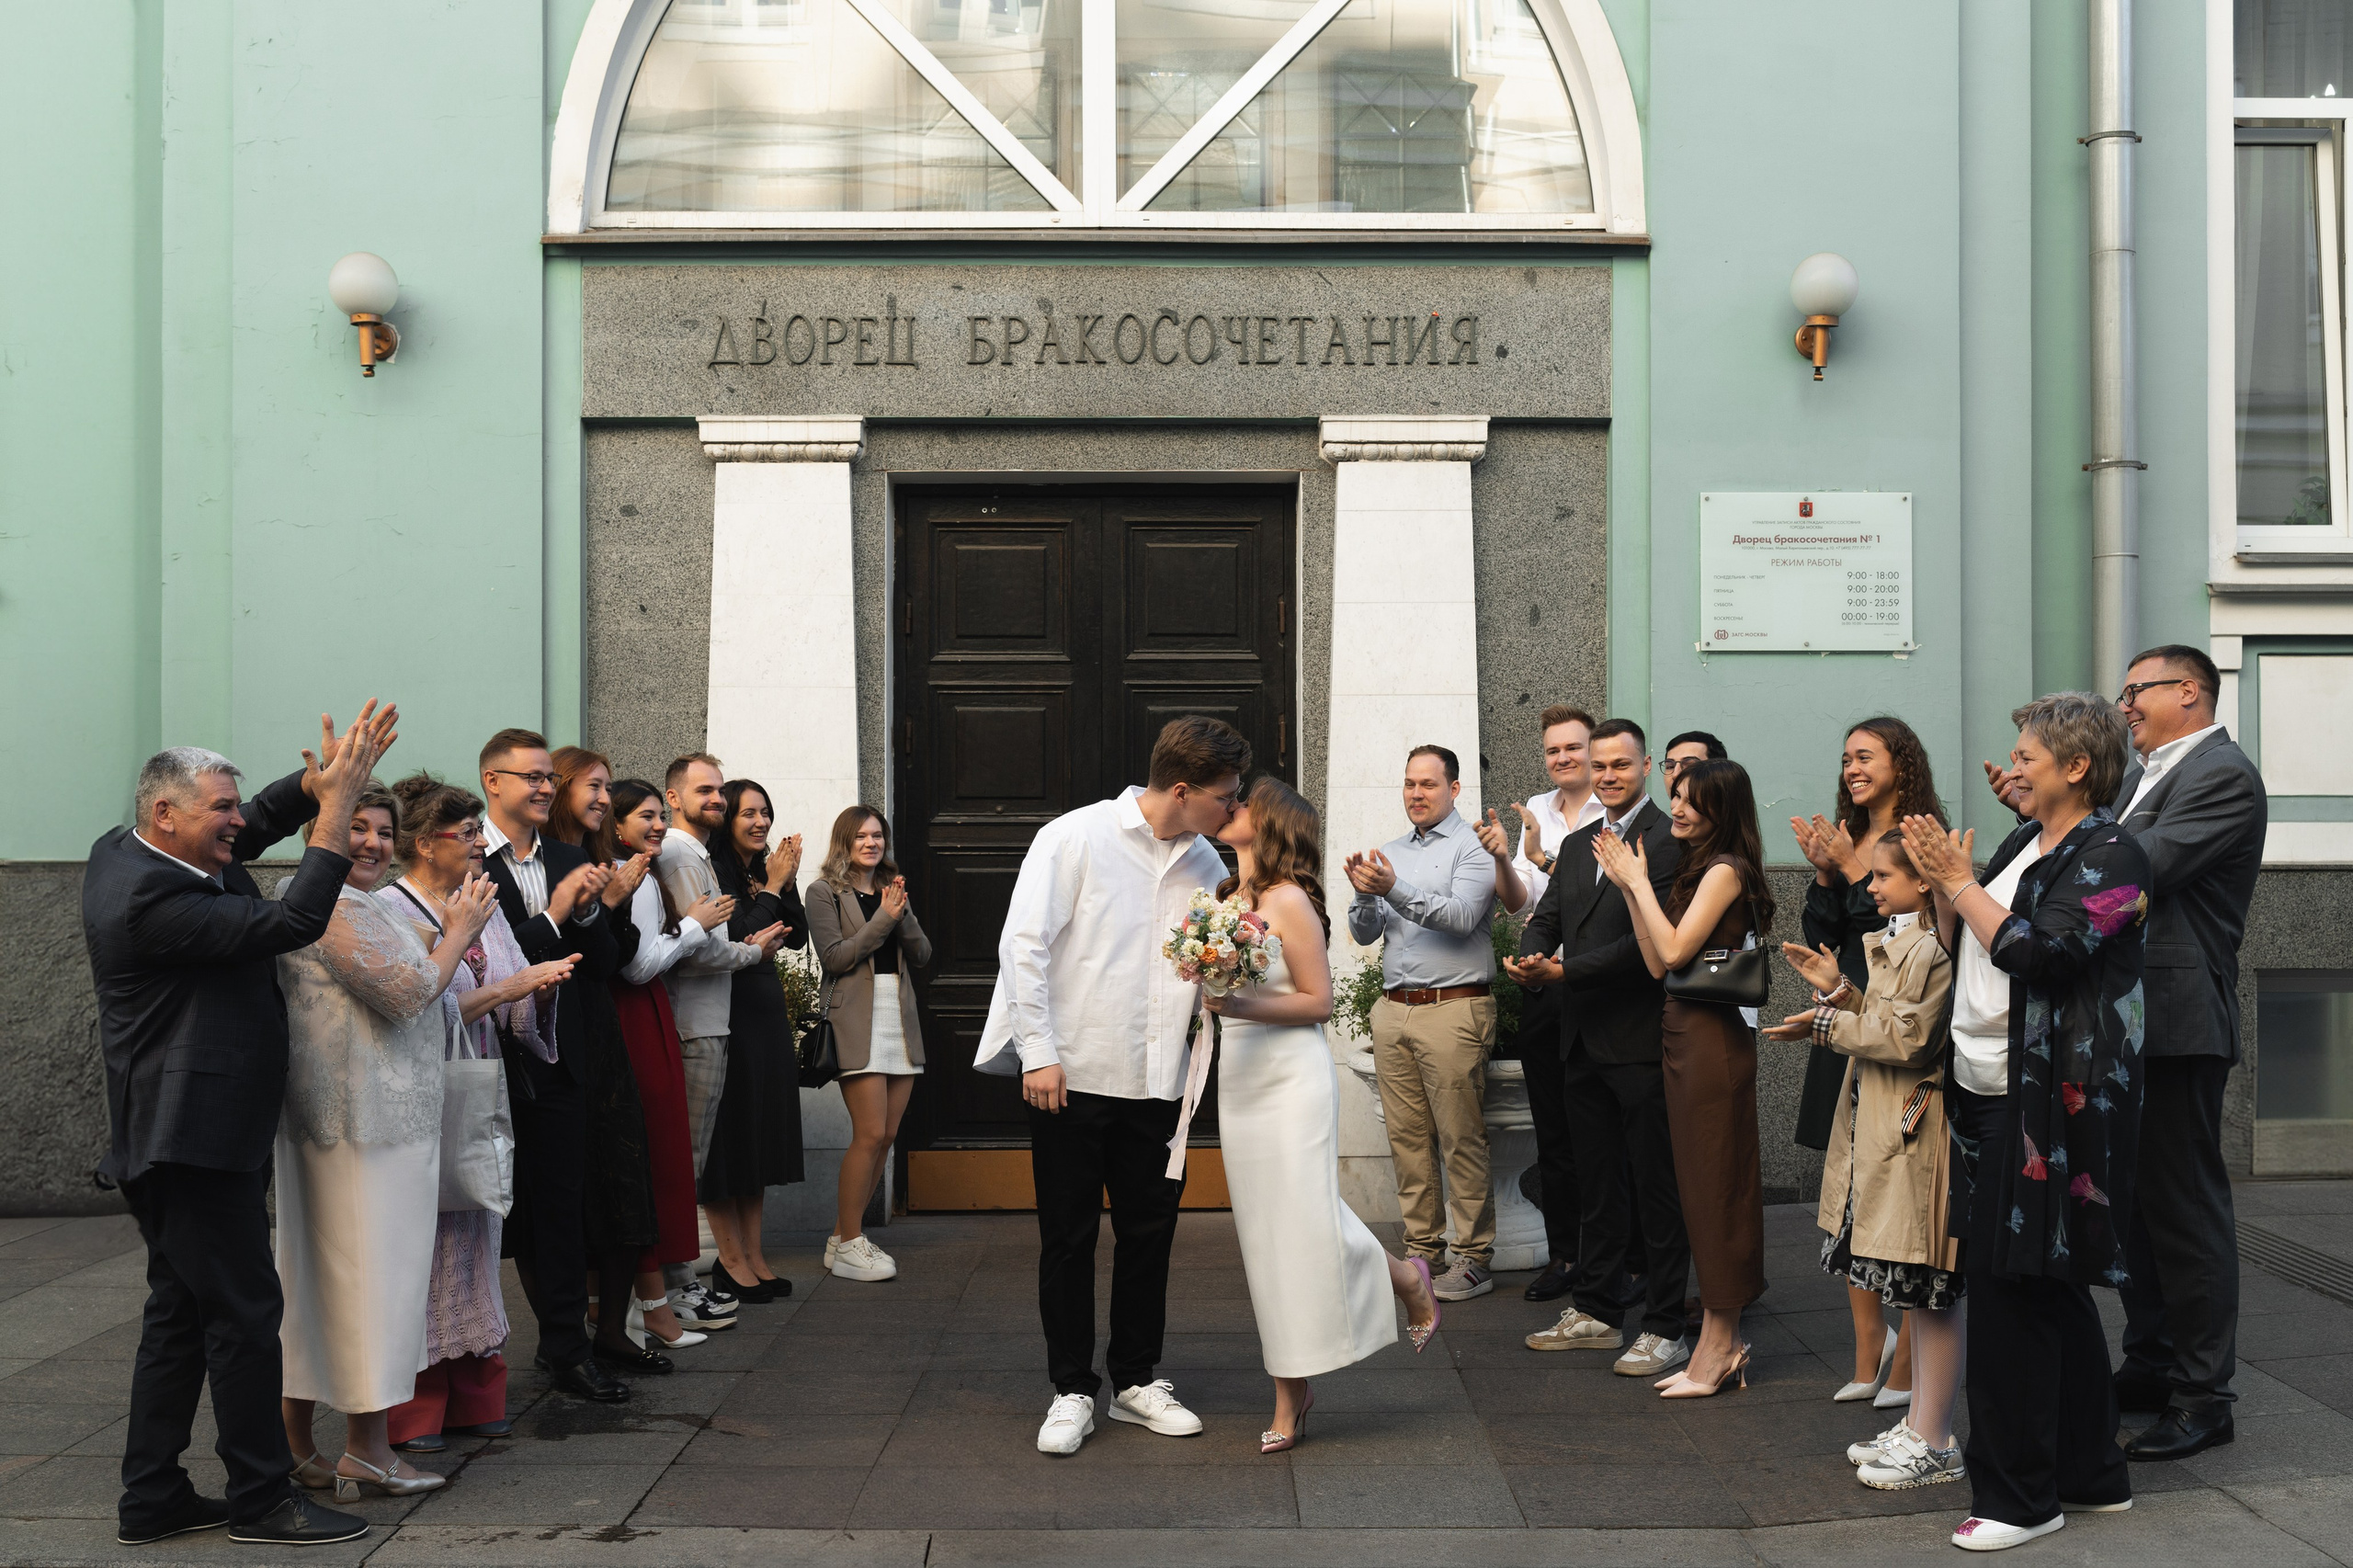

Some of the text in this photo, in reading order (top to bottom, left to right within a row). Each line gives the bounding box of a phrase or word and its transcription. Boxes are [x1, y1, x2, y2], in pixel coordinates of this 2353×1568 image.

[707, 313, 1481, 369] ДВОРЕЦ БРАКОСОЧЕТАНИЯ
[1733, 535, 1772, 545] Дворец
[1775, 534, 1858, 545] бракосочетания
[1876, 535, 1881, 543] 1
[1770, 559, 1842, 567] РЕЖИМ РАБОТЫ
[1847, 572, 1867, 580] 9:00
[1875, 572, 1900, 580] 18:00
[1847, 585, 1867, 594] 9:00
[1874, 585, 1900, 594] 20:00
[1847, 599, 1867, 608] 9:00
[1874, 599, 1900, 608] 23:59
[1841, 612, 1867, 620] 00:00
[1875, 612, 1900, 620] 19:00
